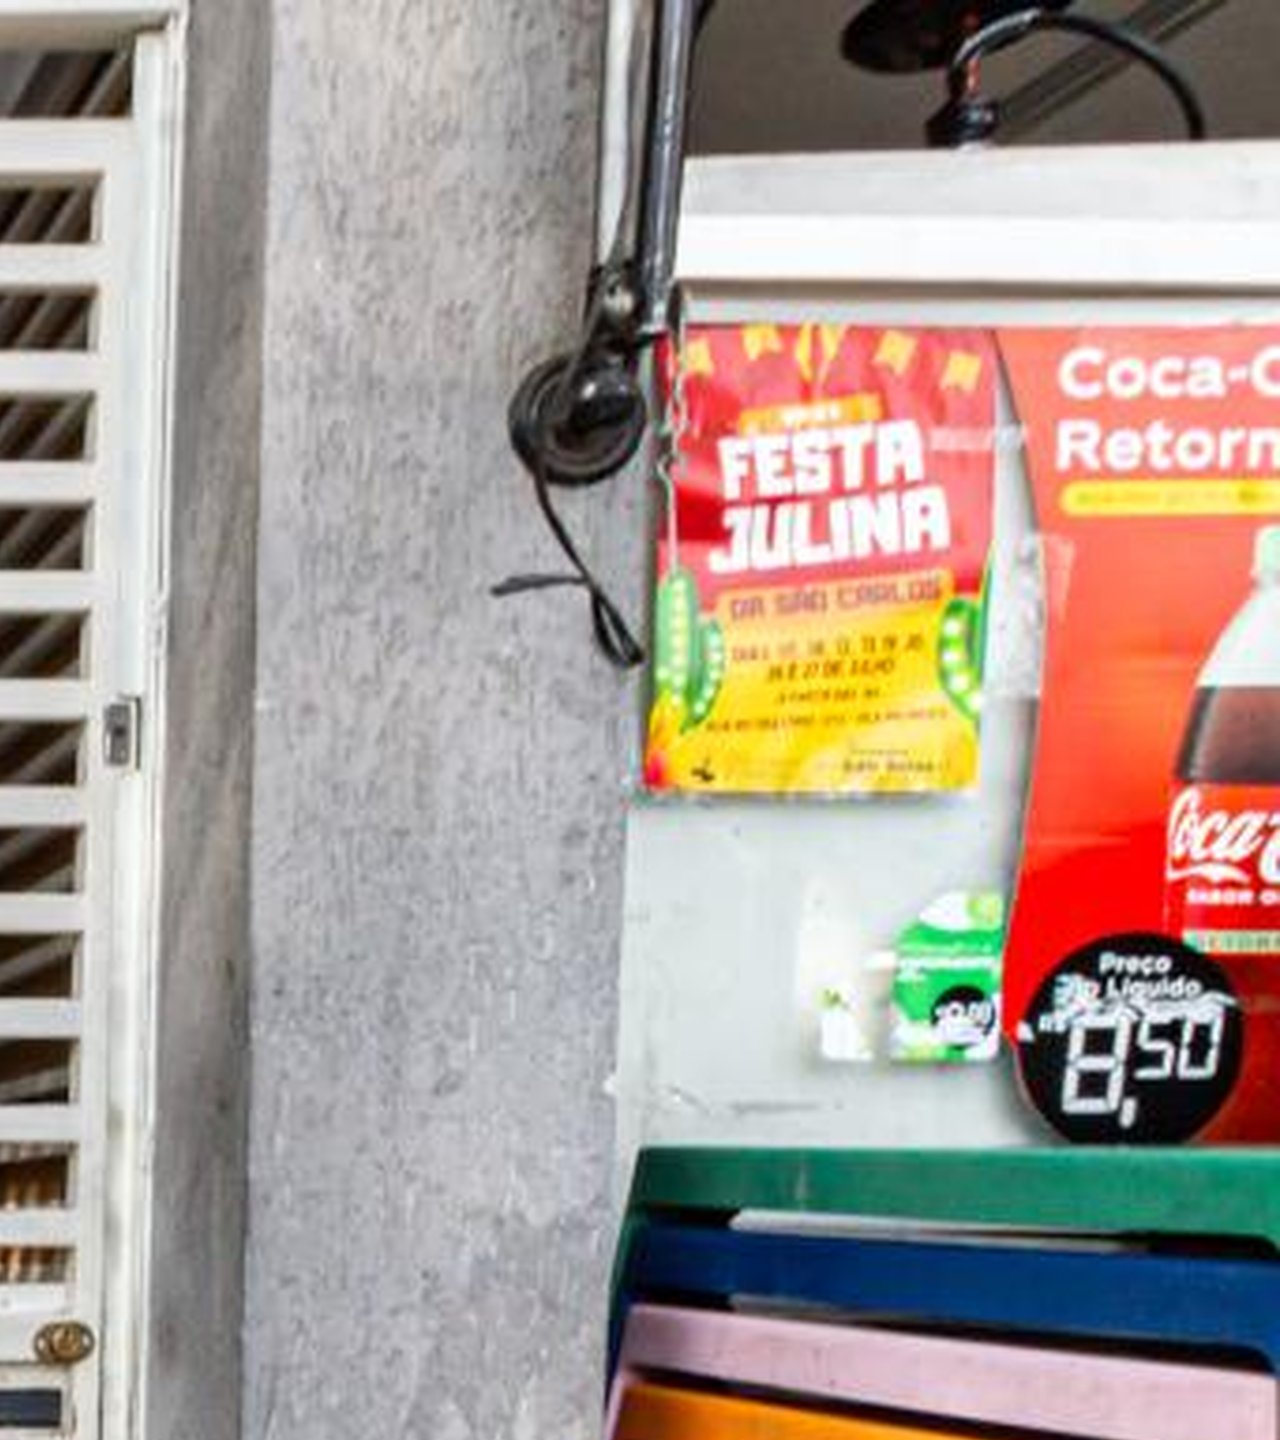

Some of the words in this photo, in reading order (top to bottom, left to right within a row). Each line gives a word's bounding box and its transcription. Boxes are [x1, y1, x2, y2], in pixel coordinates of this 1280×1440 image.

[718, 419, 925, 501] FESTA
[709, 486, 952, 574] JULINA
[1099, 951, 1172, 976] Preço
